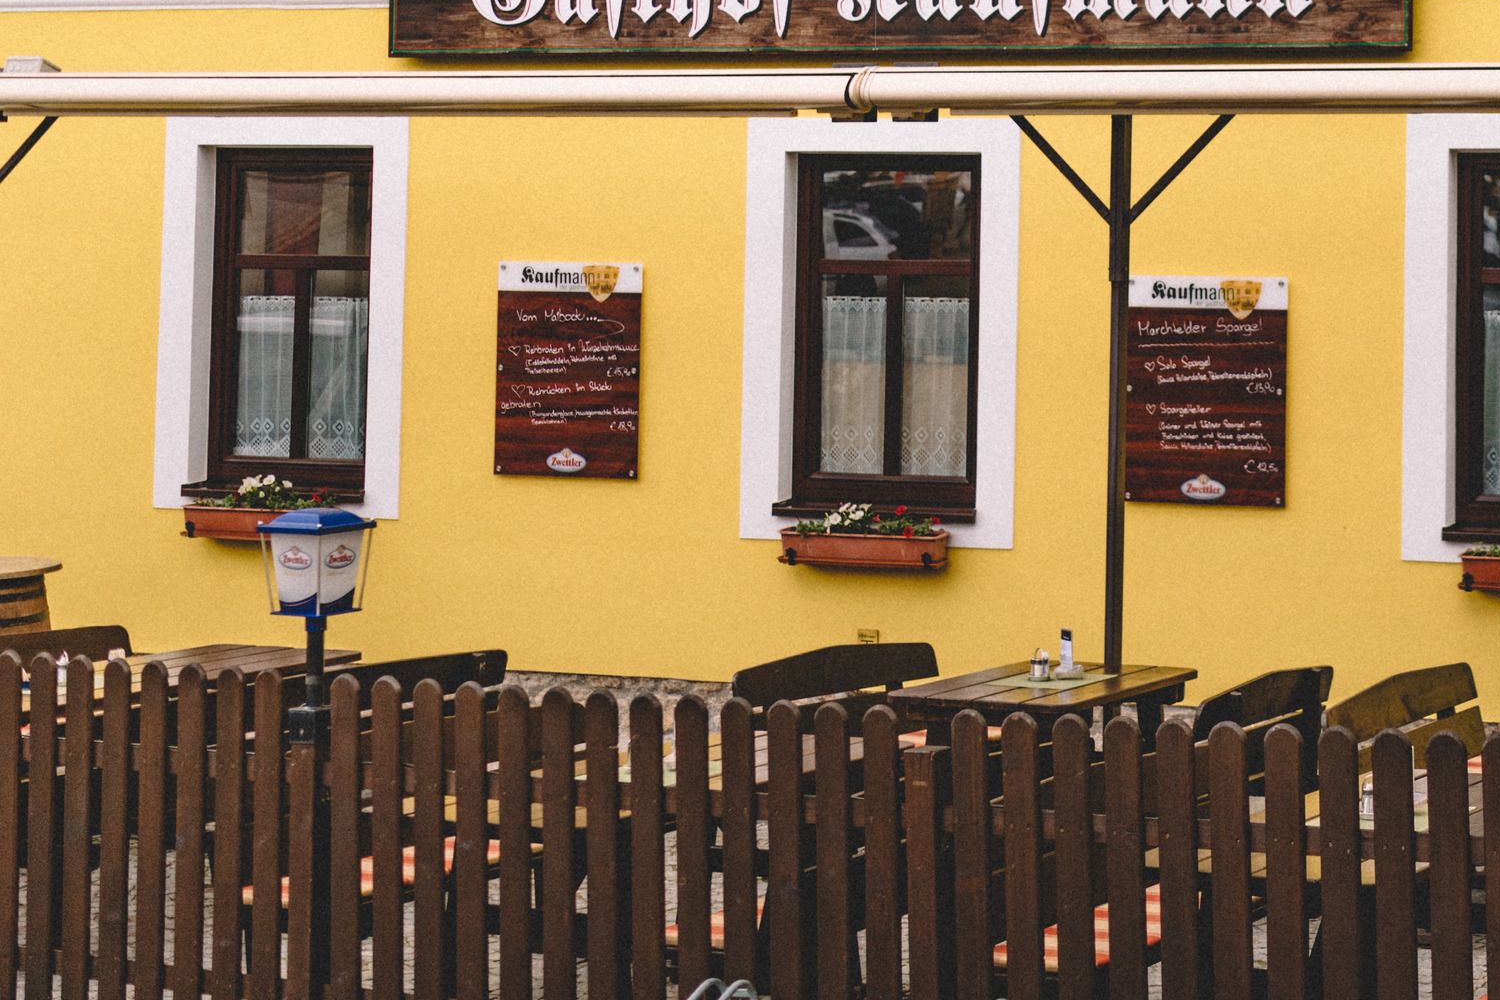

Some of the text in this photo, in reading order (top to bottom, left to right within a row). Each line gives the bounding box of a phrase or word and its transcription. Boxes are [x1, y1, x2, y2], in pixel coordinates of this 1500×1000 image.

[521, 265, 595, 288] Kaufmann
[1151, 280, 1235, 304] Kaufmann
[516, 308, 537, 322] Vom
[1138, 320, 1207, 337] Marchfelder
[524, 344, 564, 354] Rehbraten
[567, 343, 576, 352] in
[1157, 354, 1211, 371] Solo Spargel
[526, 381, 613, 396] Rehrücken im Stück
[500, 400, 542, 414] gebraten
[551, 456, 583, 468] Zwettler
[1185, 482, 1221, 495] Zwettler
